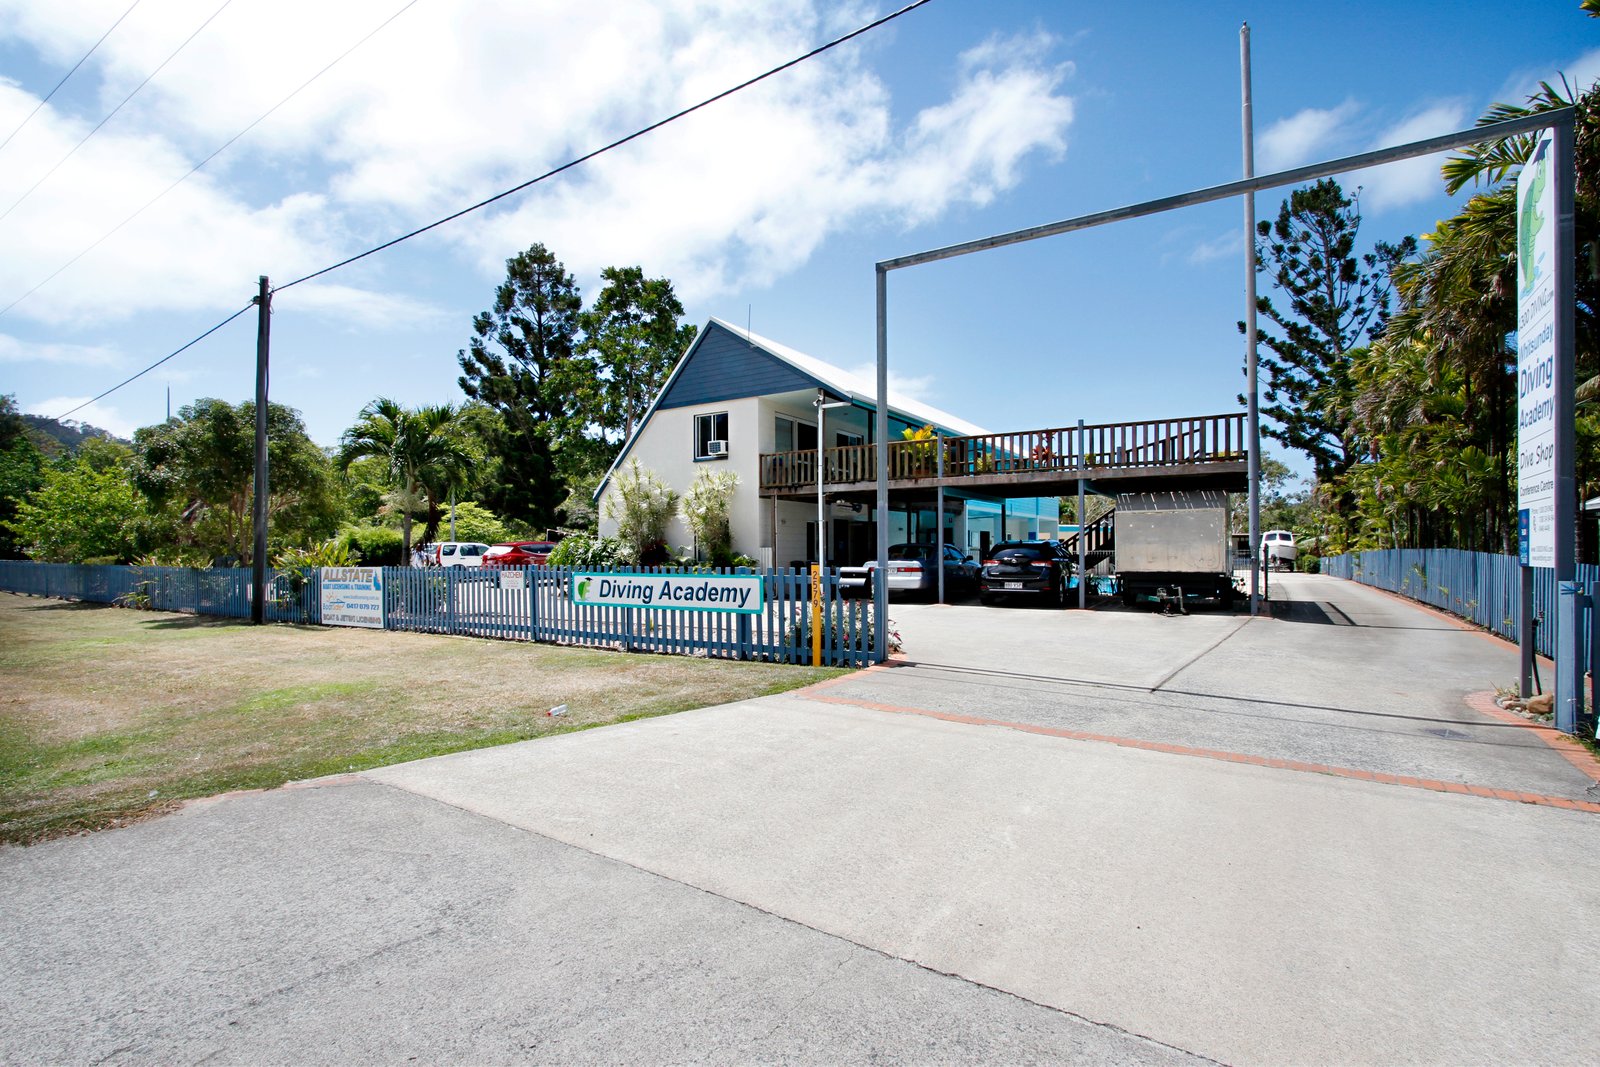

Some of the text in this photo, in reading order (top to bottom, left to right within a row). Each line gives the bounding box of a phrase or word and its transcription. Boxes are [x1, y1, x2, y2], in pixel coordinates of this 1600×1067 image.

[1519, 321, 1554, 362] Whitsunday
[1520, 354, 1553, 399] Diving
[1519, 395, 1554, 430] Academy
[1520, 441, 1554, 469] Dive Shop
[1520, 480, 1554, 497] Conference Centre
[323, 569, 373, 582] ALLSTATE
[599, 579, 751, 608] Diving Academy
[323, 613, 335, 621] BOAT
[356, 615, 381, 624] LICENSING
